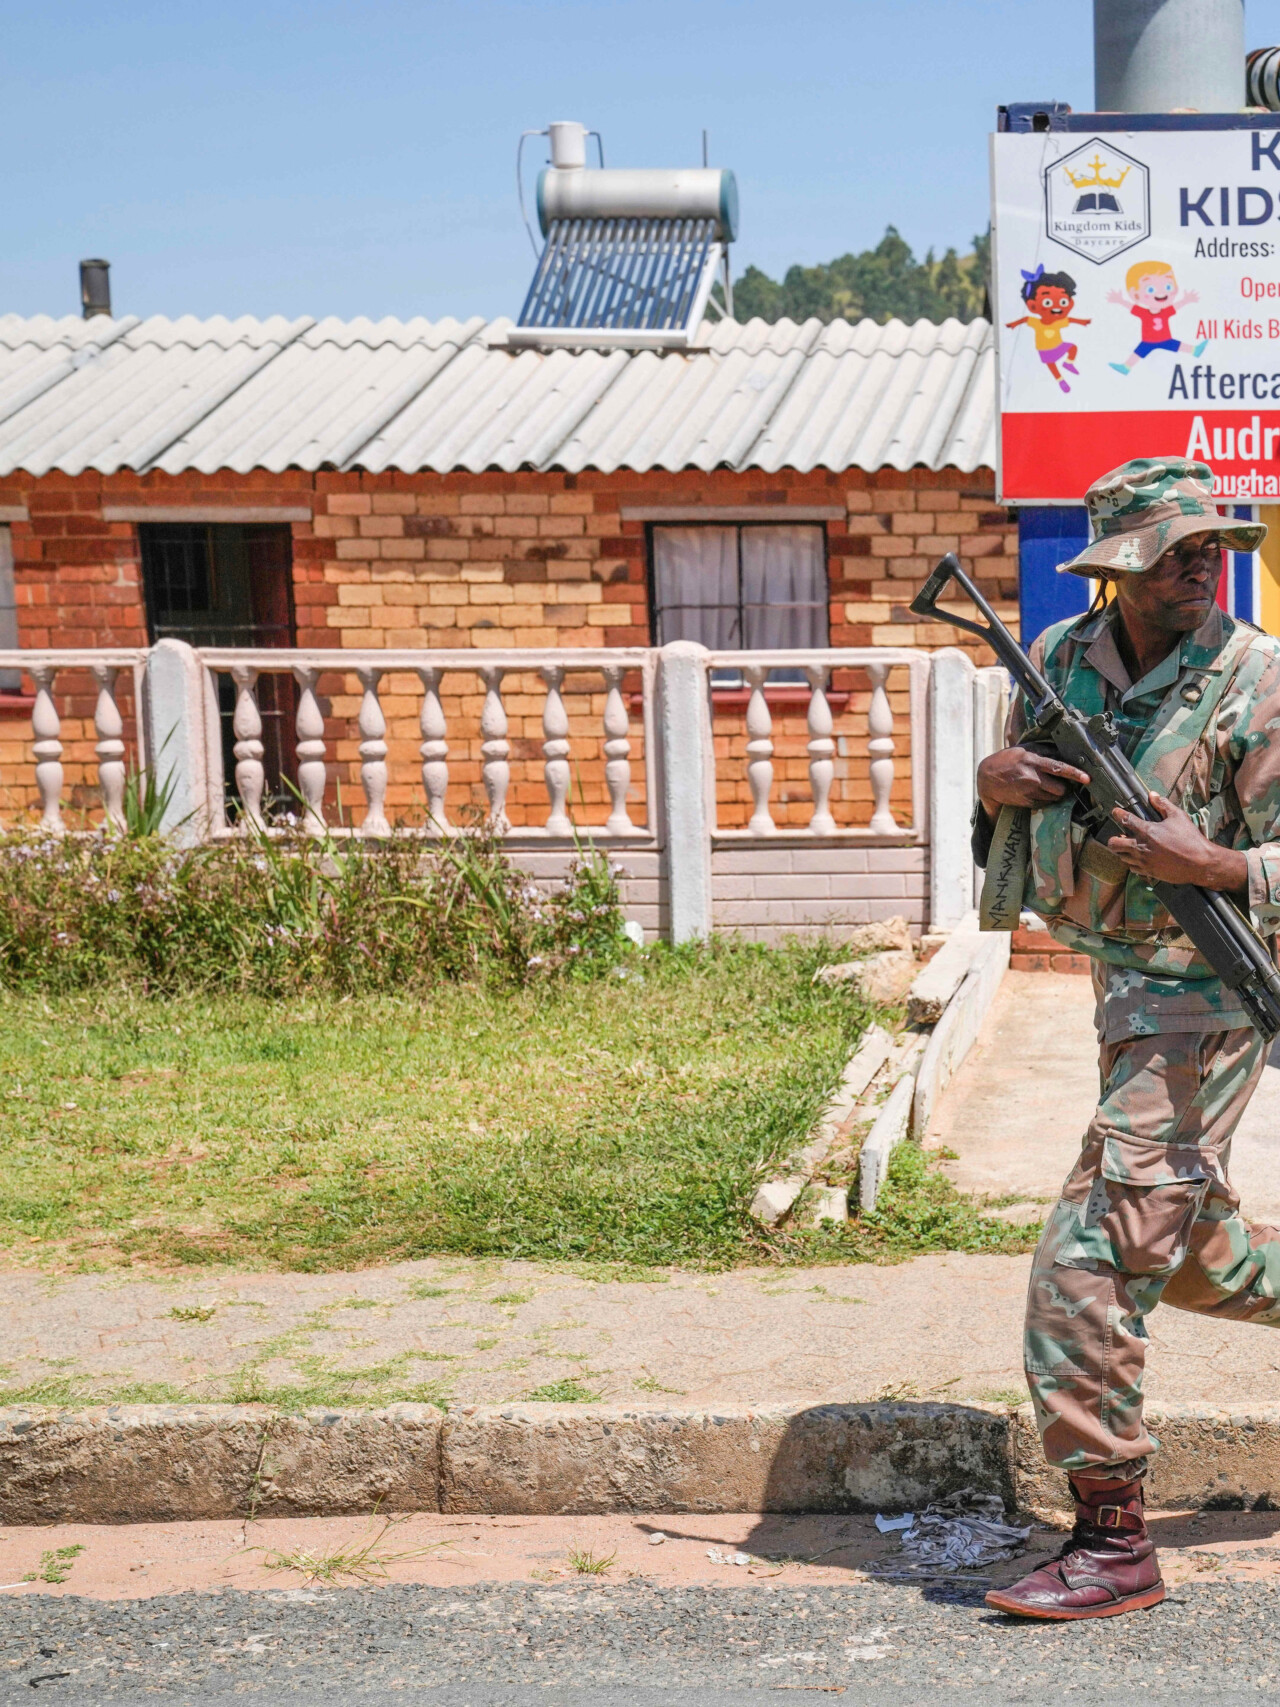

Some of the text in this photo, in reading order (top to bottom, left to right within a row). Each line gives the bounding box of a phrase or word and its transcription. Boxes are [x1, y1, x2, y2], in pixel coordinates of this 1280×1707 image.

[1054, 220, 1142, 233] Kingdom Kids
[1075, 238, 1124, 247] Daycare
[1194, 236, 1275, 258] Address:
[1195, 319, 1218, 340] All
[1223, 319, 1263, 340] Kids
